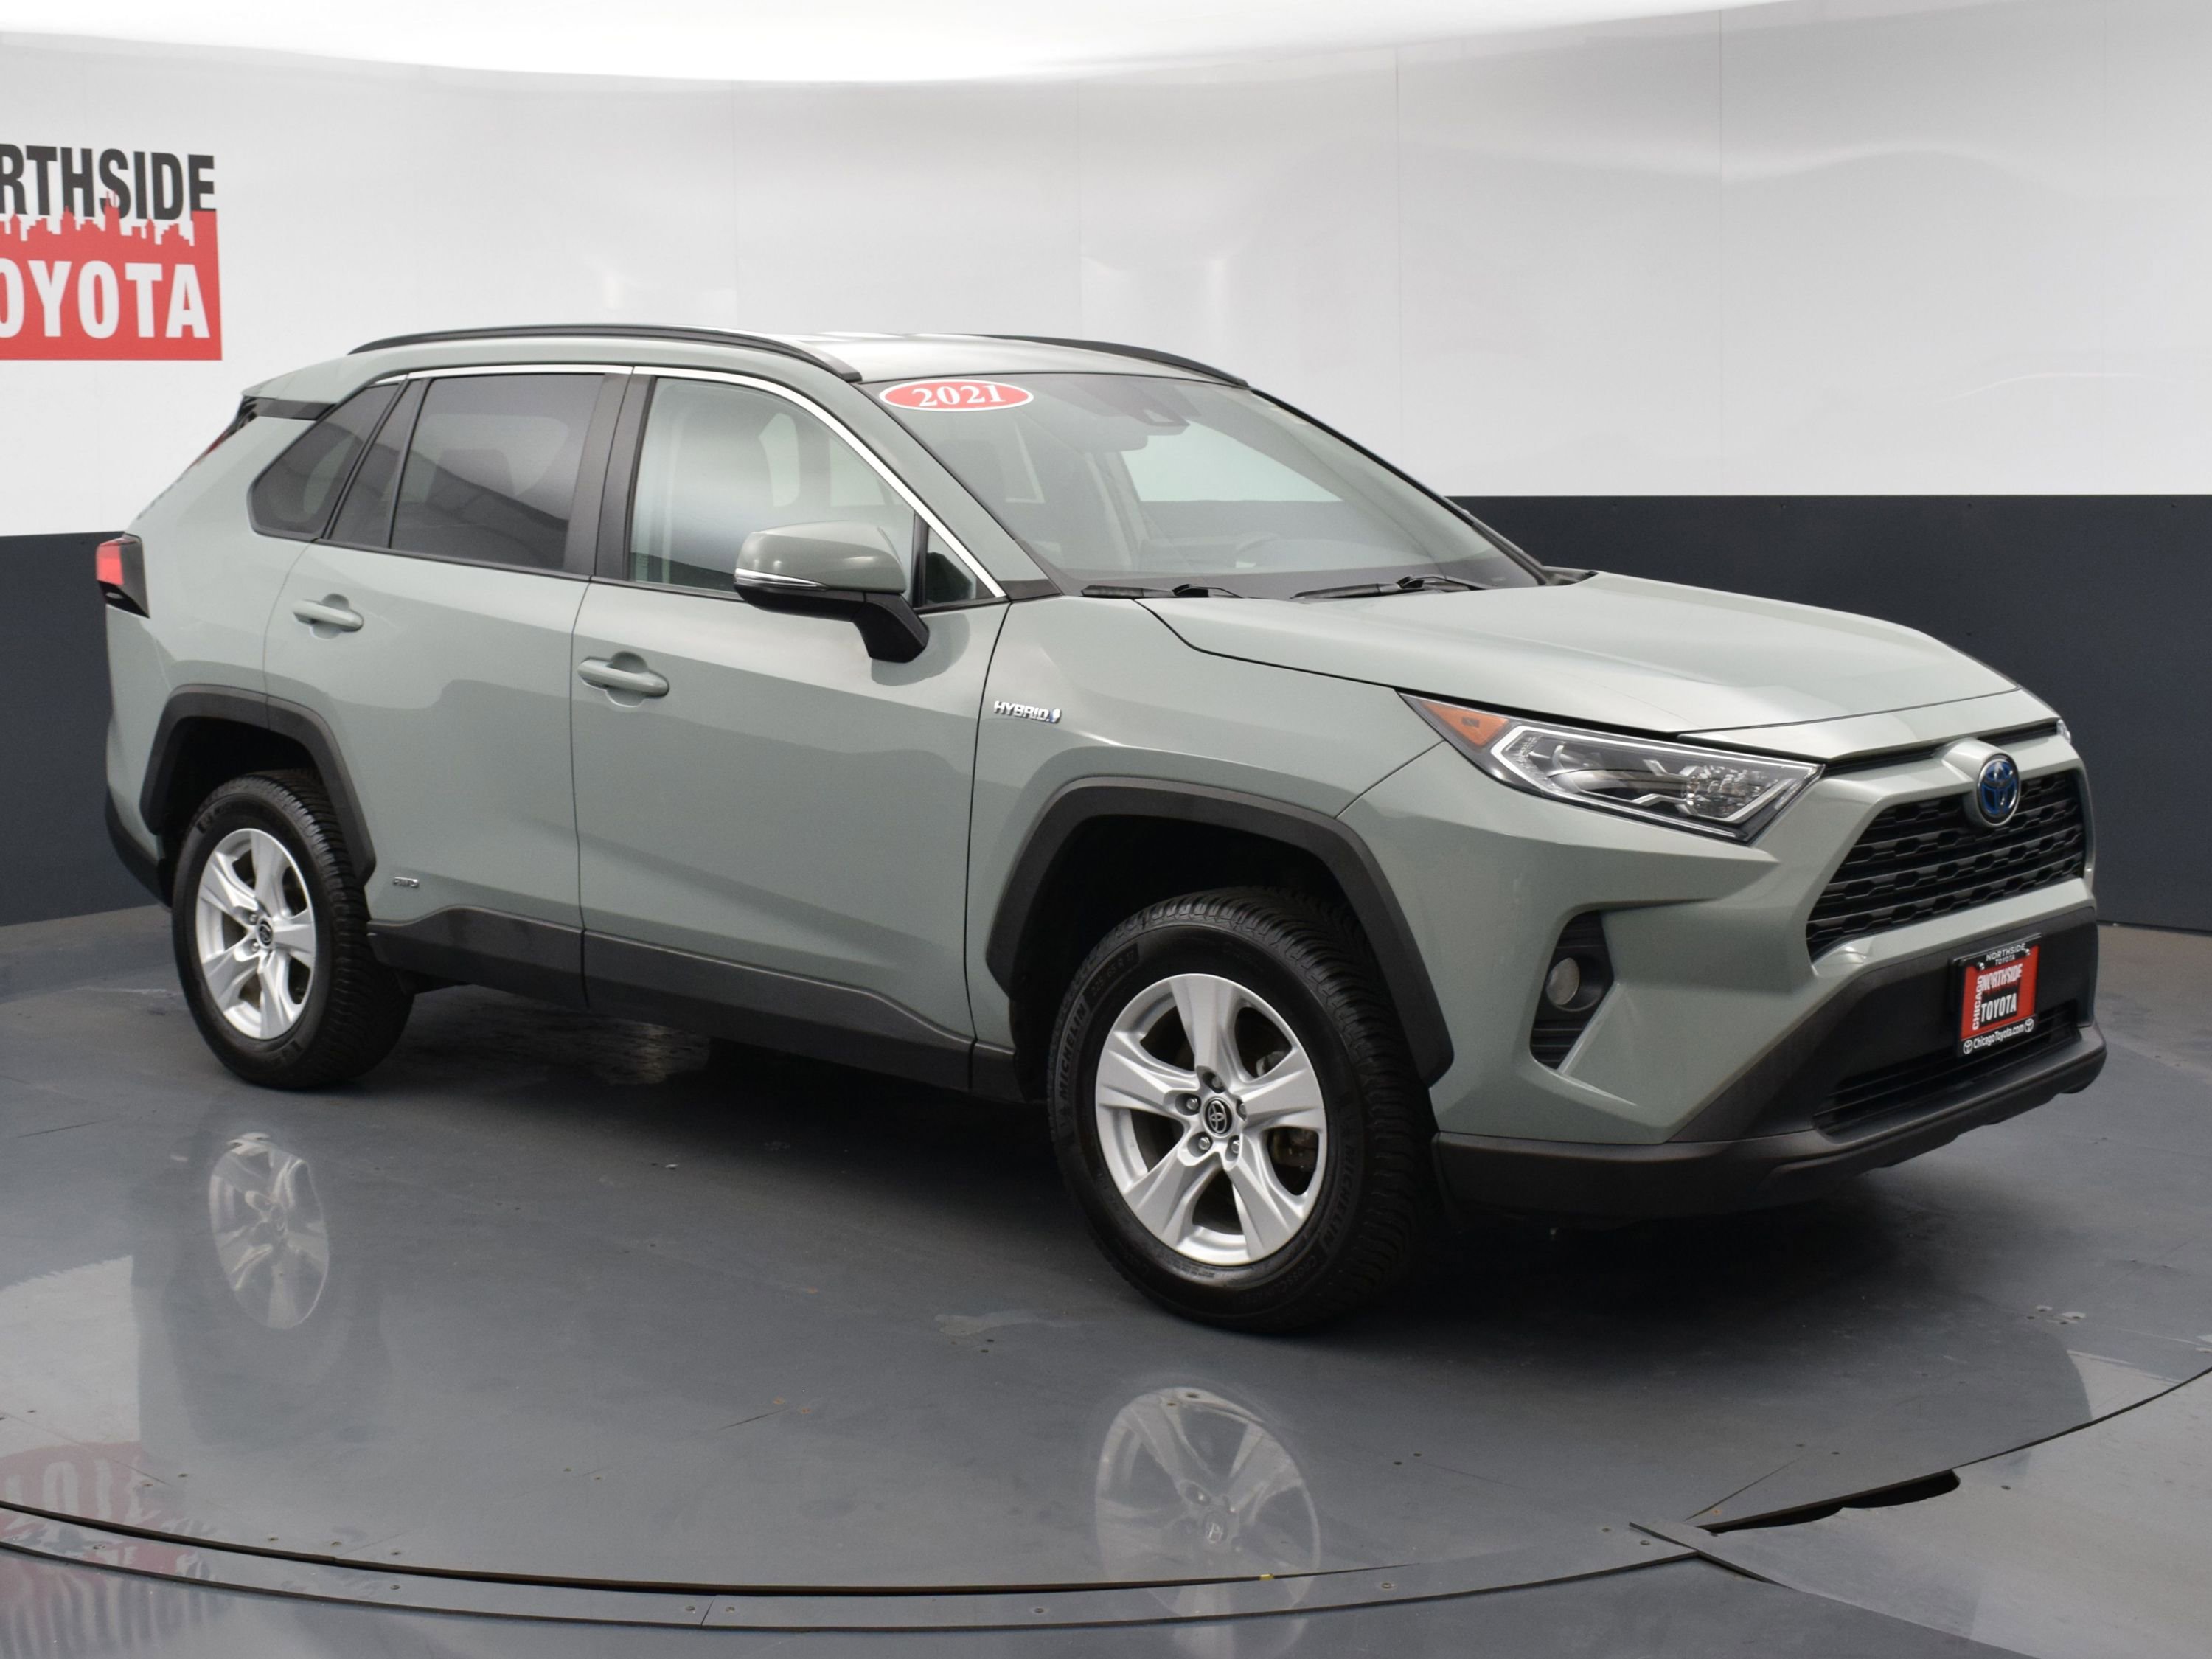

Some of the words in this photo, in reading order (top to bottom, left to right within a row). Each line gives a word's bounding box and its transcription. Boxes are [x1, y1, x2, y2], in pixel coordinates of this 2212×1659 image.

[0, 144, 216, 220] RTHSIDE
[911, 384, 1006, 406] 2021
[993, 700, 1050, 721] HYBRID
[1986, 943, 2026, 961] NORTHSIDE
[1994, 954, 2016, 966] TOYOTA
[1981, 963, 2023, 991] NORTHSIDE
[1972, 975, 1983, 1031] CHICAGO
[1980, 992, 2017, 1023] TOYOTA
[1974, 1024, 2025, 1048] ChicagoToyota.com
[1059, 1001, 1087, 1100] MICHELIN
[1323, 1144, 1357, 1246] MICHELIN
